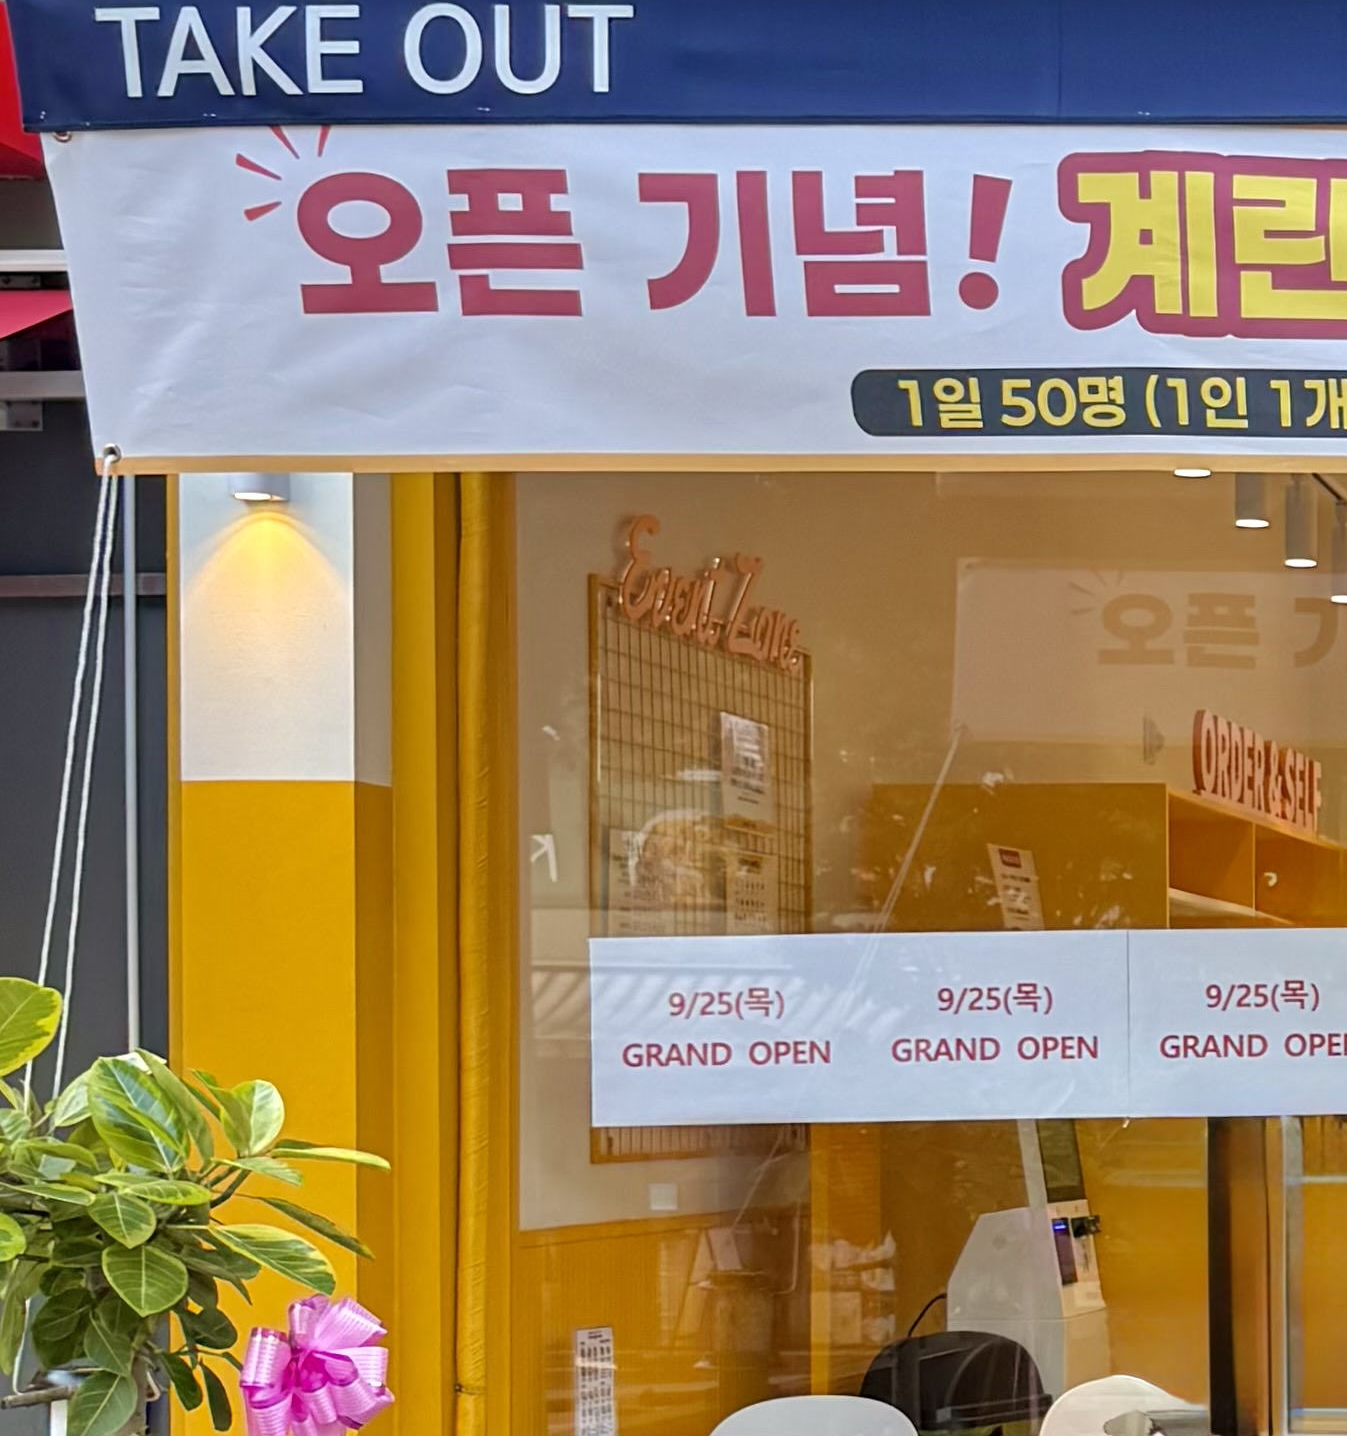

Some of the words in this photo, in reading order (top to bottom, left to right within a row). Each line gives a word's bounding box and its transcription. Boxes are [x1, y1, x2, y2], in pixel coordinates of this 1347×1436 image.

[94, 4, 364, 99] TAKE
[403, 2, 635, 96] OUT
[296, 168, 585, 318] 오픈
[638, 169, 1013, 319] 기념!
[896, 375, 983, 429] 1일
[1000, 375, 1126, 430] 50명
[1145, 374, 1249, 431] (1인
[667, 986, 786, 1020] 9/25(목)
[936, 982, 1054, 1015] 9/25(목)
[1204, 979, 1320, 1012] 9/25(목)
[621, 1041, 732, 1068] GRAND
[747, 1040, 832, 1065] OPEN
[890, 1036, 1001, 1063] GRAND
[1015, 1035, 1100, 1061] OPEN
[1159, 1034, 1268, 1059] GRAND
